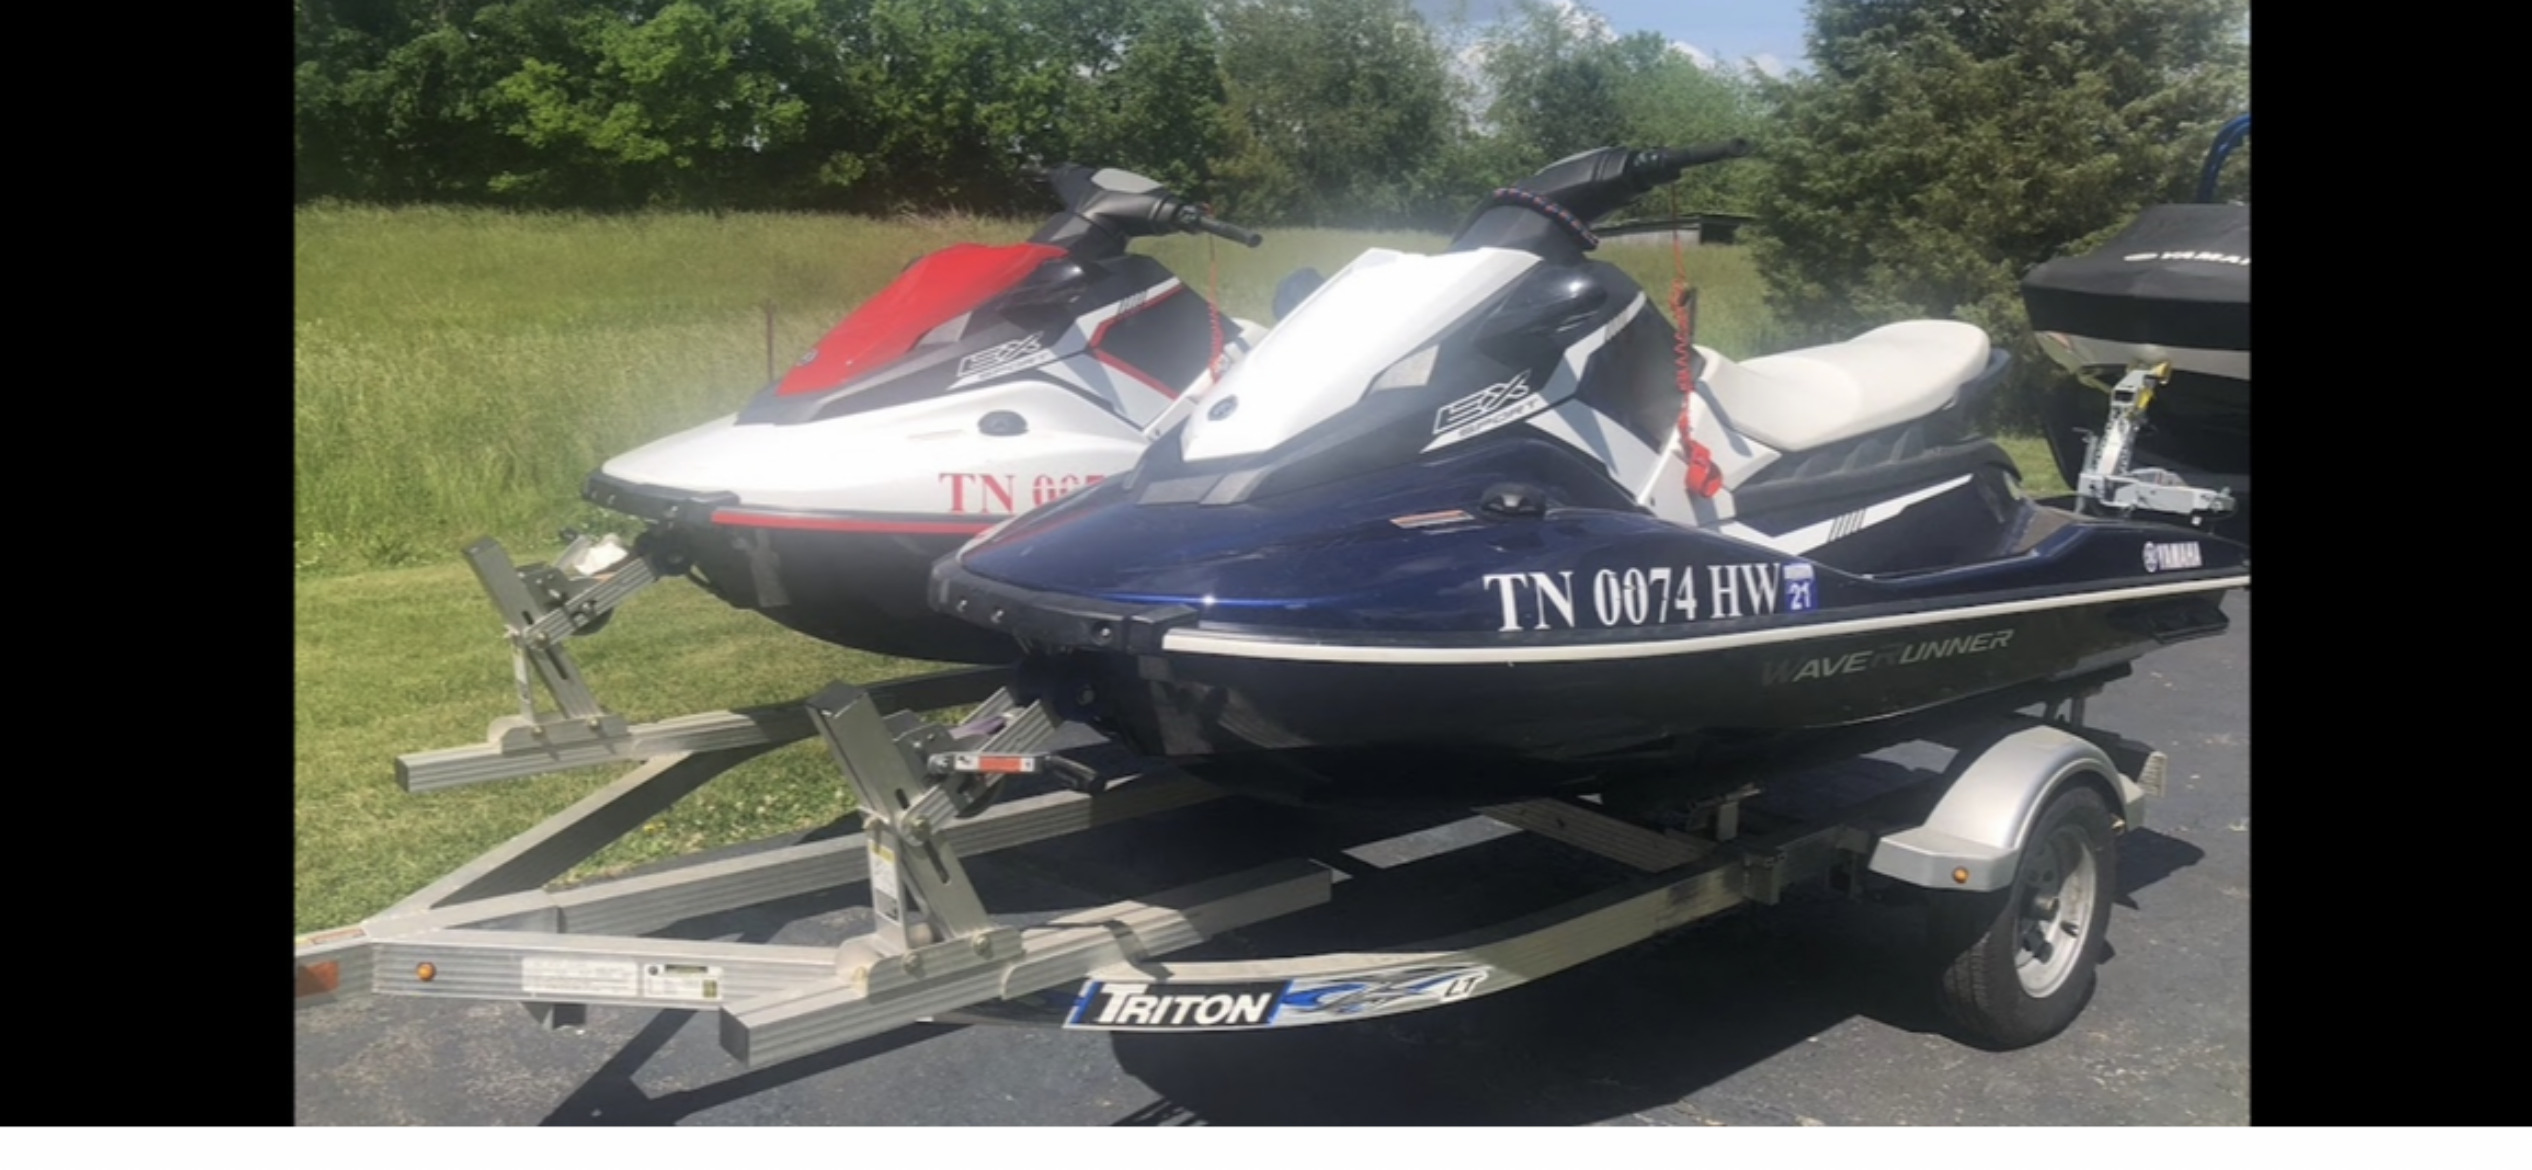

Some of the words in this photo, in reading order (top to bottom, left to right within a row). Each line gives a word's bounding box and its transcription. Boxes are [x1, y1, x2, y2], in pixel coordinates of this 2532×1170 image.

[1432, 367, 1532, 435] EX
[938, 472, 1016, 516] TN
[1482, 570, 1576, 632] TN
[1593, 565, 1698, 627] 0074
[1707, 562, 1781, 619] HW
[1788, 581, 1812, 611] 21
[1761, 628, 2016, 687] WAVERUNNER
[1097, 982, 1273, 1026] TRITON
[1444, 975, 1479, 998] LT
